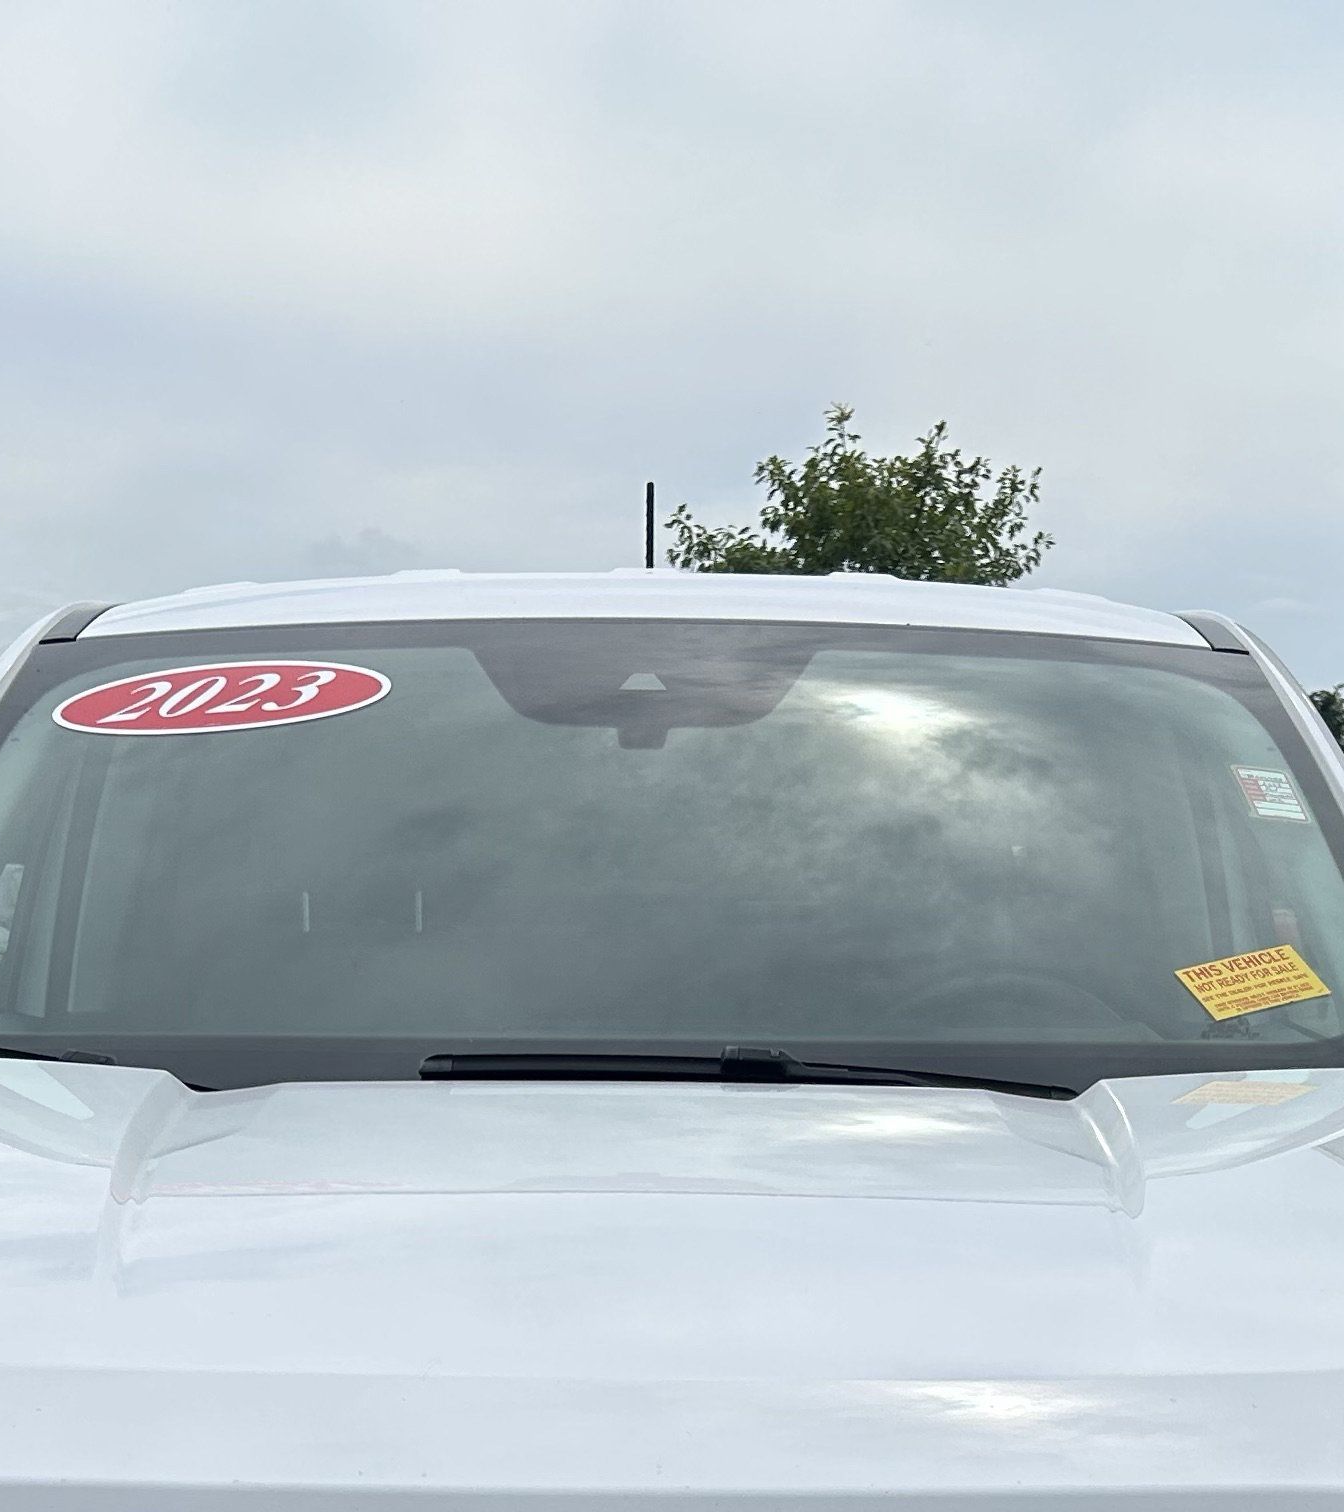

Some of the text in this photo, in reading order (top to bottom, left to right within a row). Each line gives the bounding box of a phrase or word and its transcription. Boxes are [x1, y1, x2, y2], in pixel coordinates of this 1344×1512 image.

[96, 670, 336, 724] 2023
[1182, 949, 1290, 983] THIS VEHICLE
[1194, 962, 1299, 993] NOT READY FOR SALE
